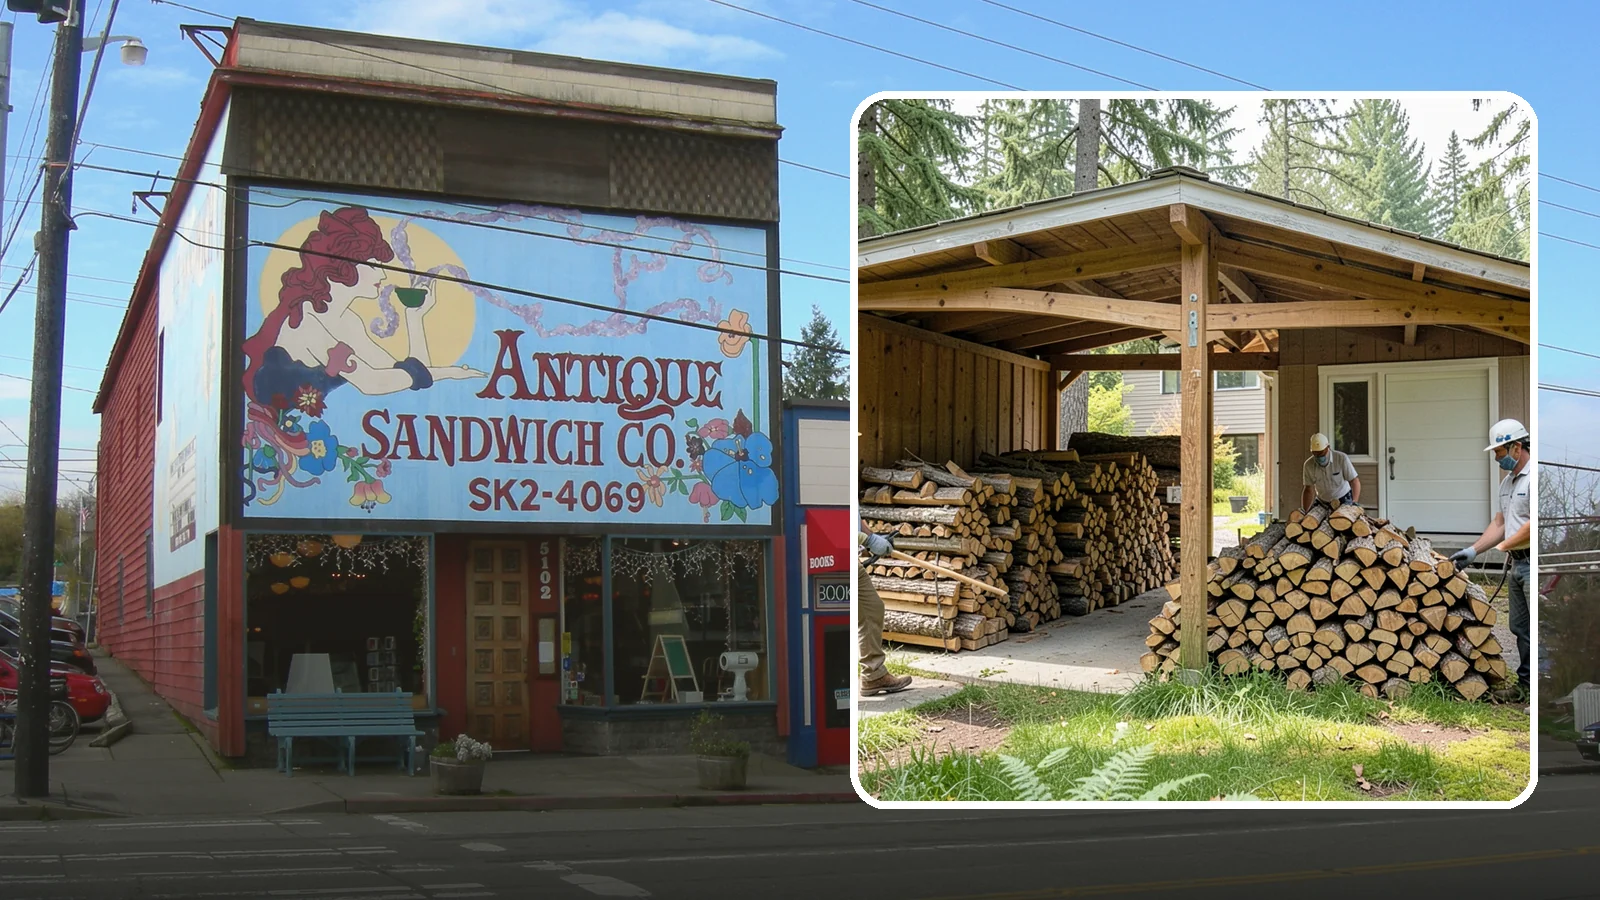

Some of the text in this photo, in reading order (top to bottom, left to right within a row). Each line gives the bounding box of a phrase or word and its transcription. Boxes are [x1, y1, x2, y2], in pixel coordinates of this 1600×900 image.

[476, 329, 723, 420] ANTIQUE
[361, 408, 684, 468] SANDWICH CO.
[468, 477, 646, 513] SK2-4069
[540, 541, 551, 599] 5102
[810, 555, 835, 568] BOOKS
